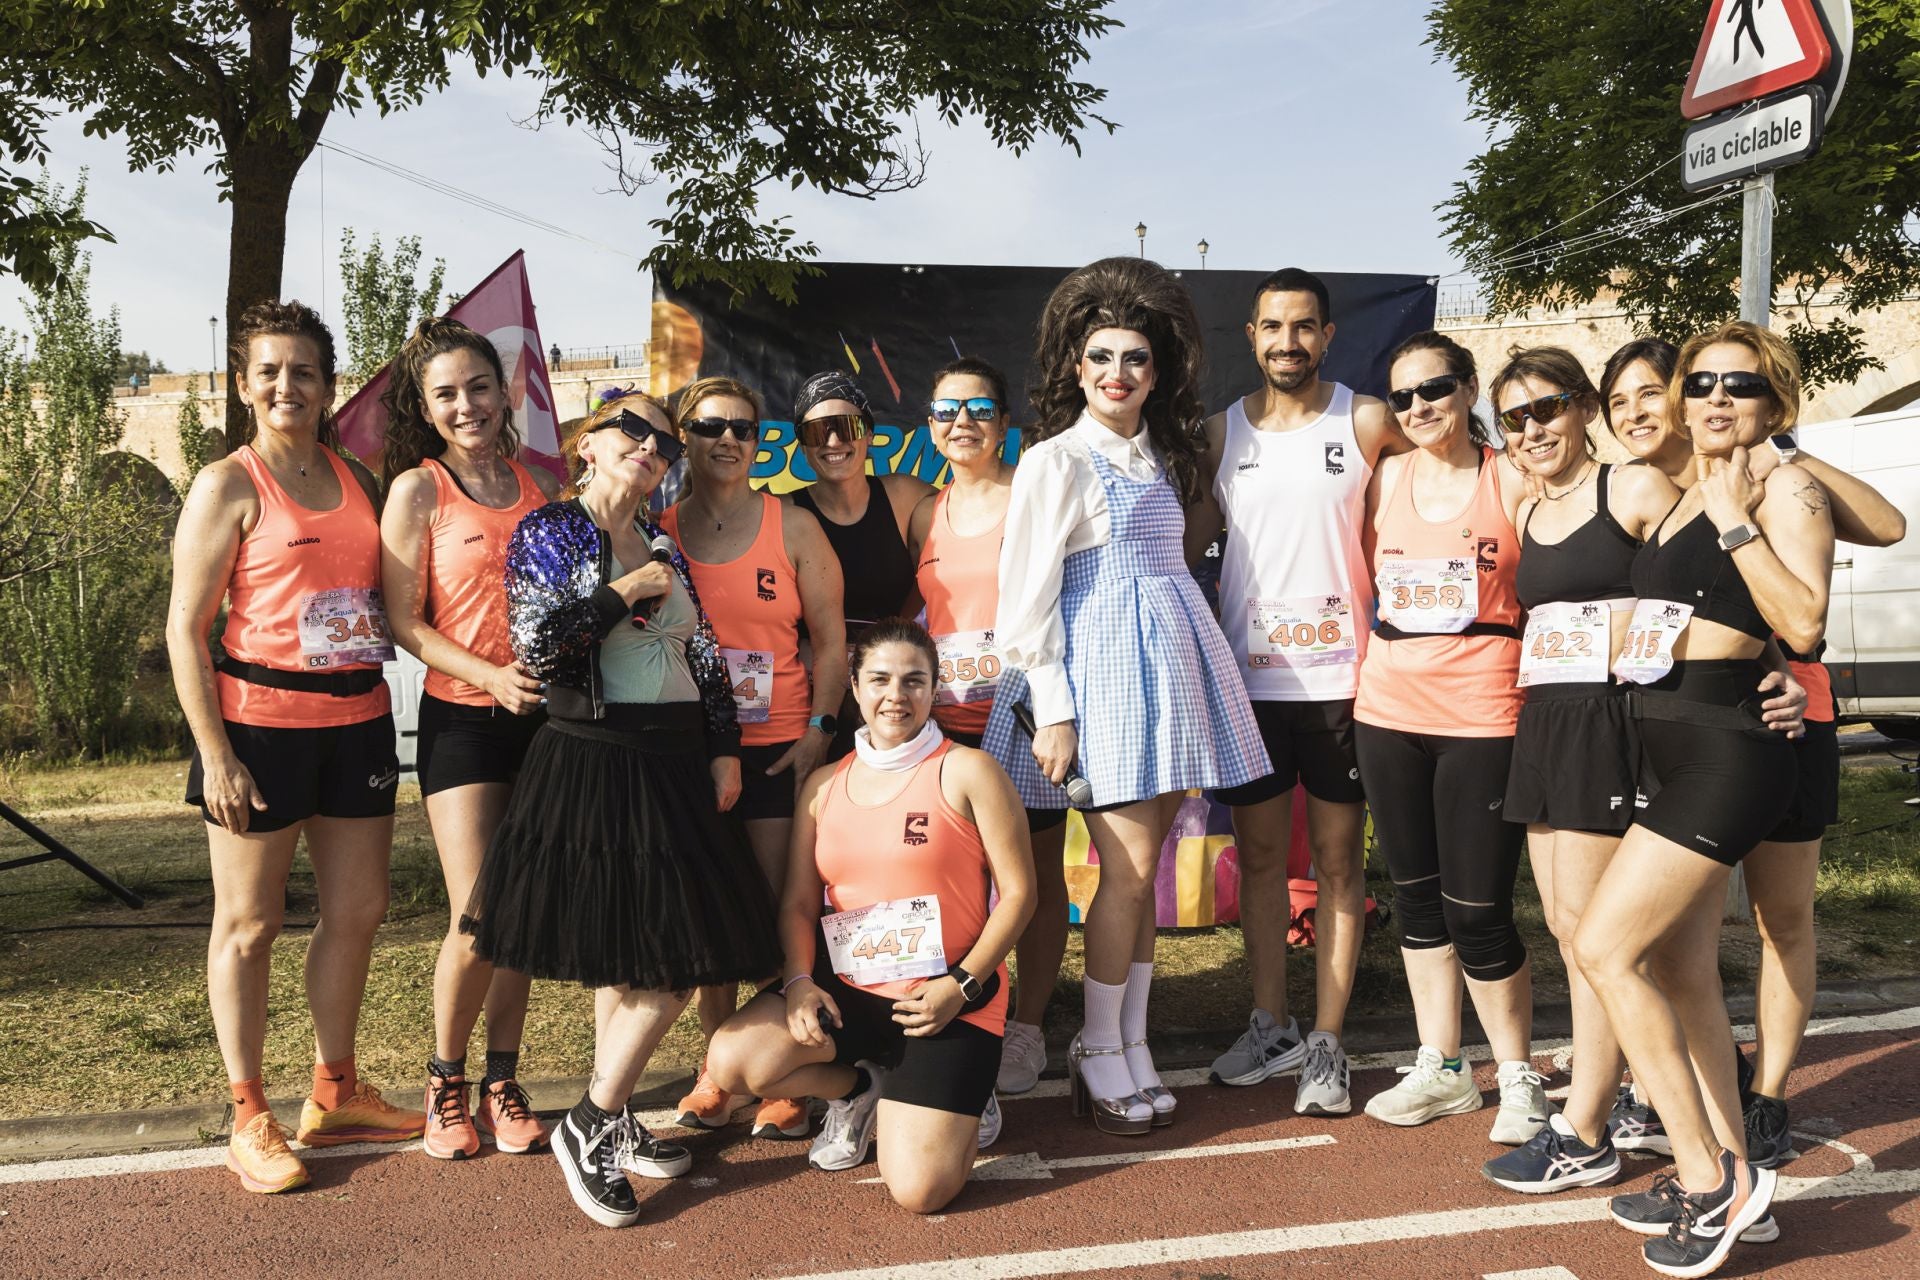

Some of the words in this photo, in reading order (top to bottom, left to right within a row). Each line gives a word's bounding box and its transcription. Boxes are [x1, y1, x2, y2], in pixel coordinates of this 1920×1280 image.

[1689, 143, 1716, 170] via
[1722, 117, 1802, 160] ciclable
[288, 537, 320, 548] GALLEGO
[464, 534, 484, 545] JUDIT
[1391, 585, 1463, 609] 358
[325, 614, 385, 642] 345
[1268, 620, 1341, 647] 406
[1531, 631, 1592, 659] 422
[1622, 630, 1663, 658] 415
[939, 655, 1001, 683] 350
[853, 926, 926, 960] 447
